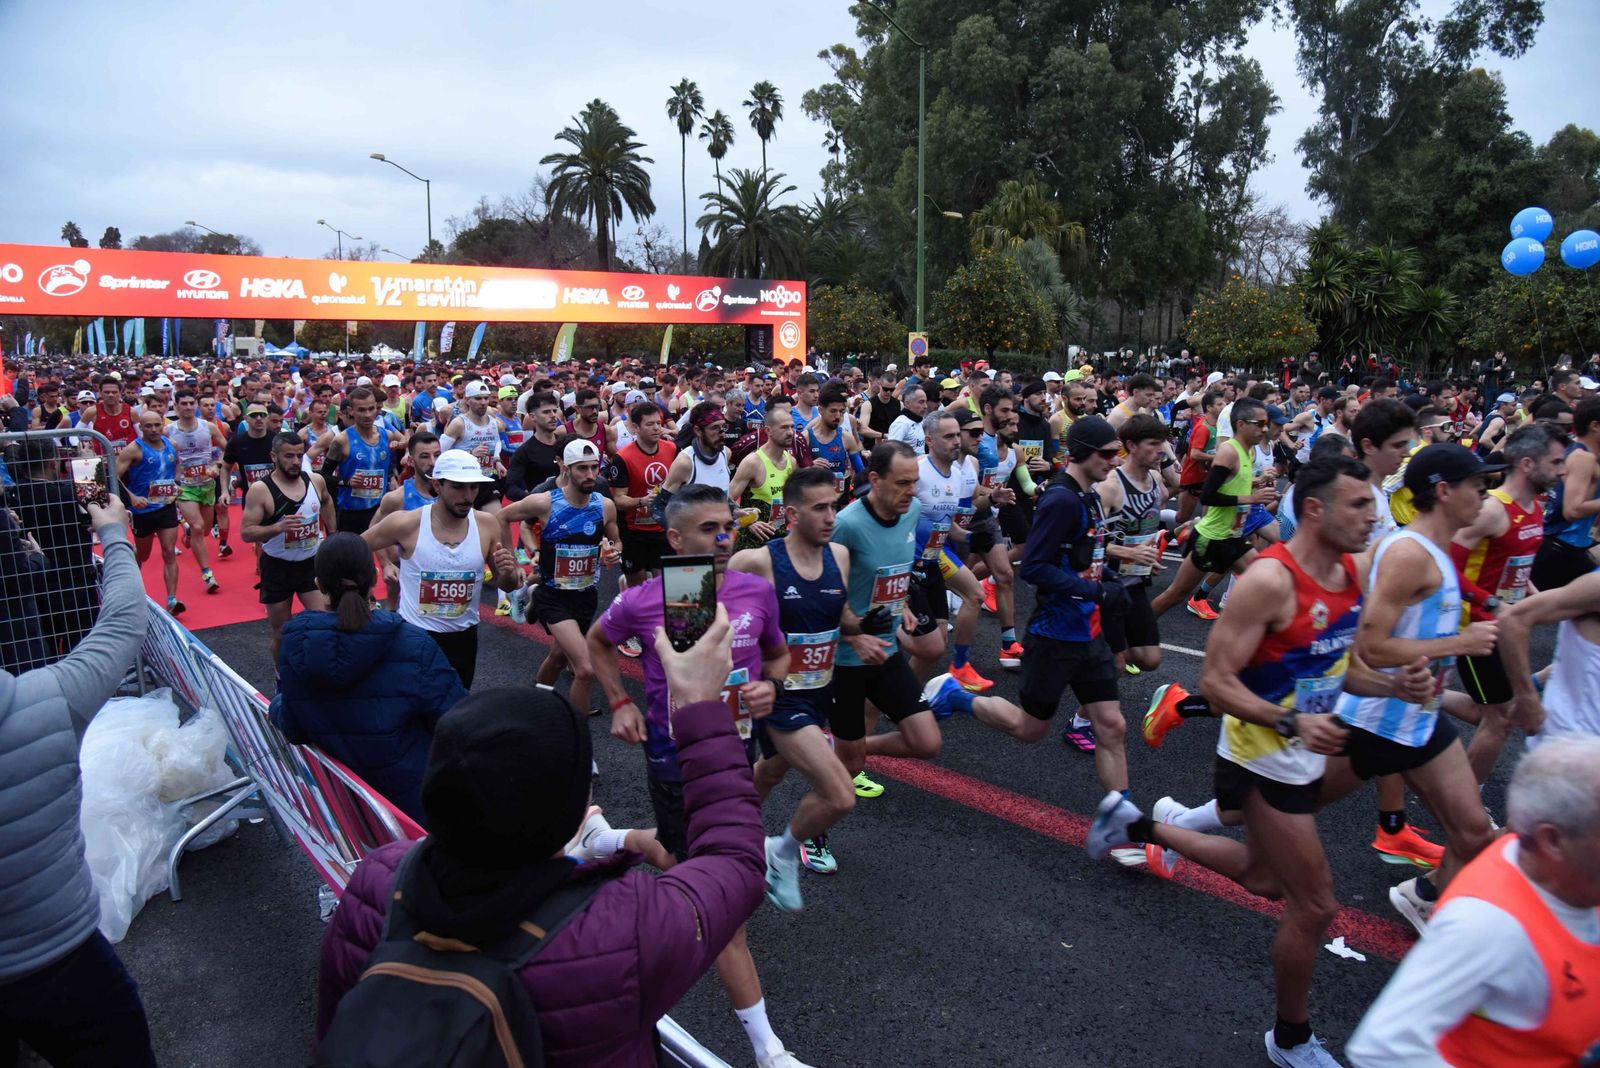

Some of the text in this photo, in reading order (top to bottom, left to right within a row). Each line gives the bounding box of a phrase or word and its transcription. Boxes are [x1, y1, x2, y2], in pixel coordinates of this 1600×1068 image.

[98, 275, 170, 290] Sprinter
[239, 277, 307, 299] HOKA
[399, 277, 477, 293] maratón
[176, 289, 229, 300] HYUNDAI
[562, 287, 610, 305] HOKA
[722, 293, 758, 306] Sprinter
[616, 300, 649, 309] HYUNDAI
[190, 465, 203, 475] 317
[362, 477, 379, 487] 513
[158, 486, 173, 495] 515
[568, 559, 589, 572] 901
[431, 582, 467, 598] 1569
[802, 645, 832, 665] 357
